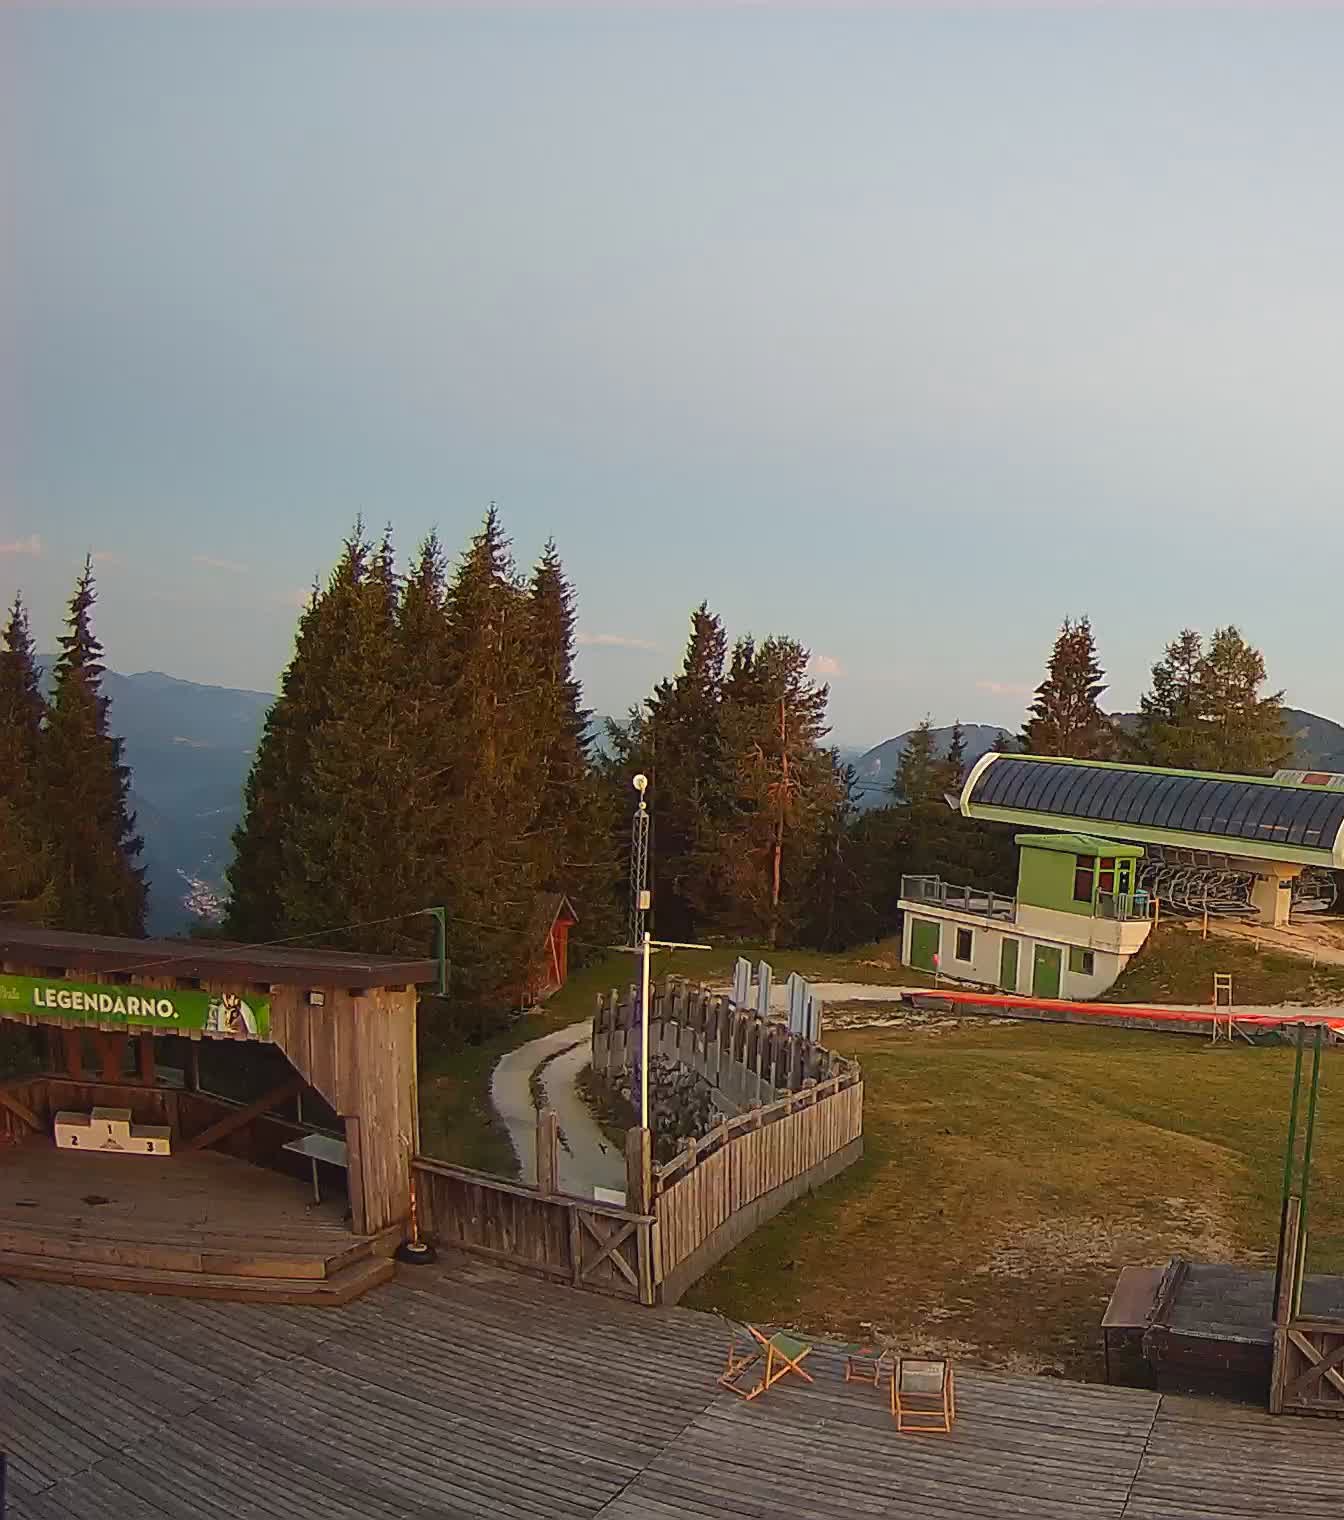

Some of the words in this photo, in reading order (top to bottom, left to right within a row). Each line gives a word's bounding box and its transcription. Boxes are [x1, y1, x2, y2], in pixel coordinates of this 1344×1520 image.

[33, 987, 180, 1019] LEGENDARNO.
[71, 1135, 79, 1146] 2
[146, 1141, 154, 1152] 3
